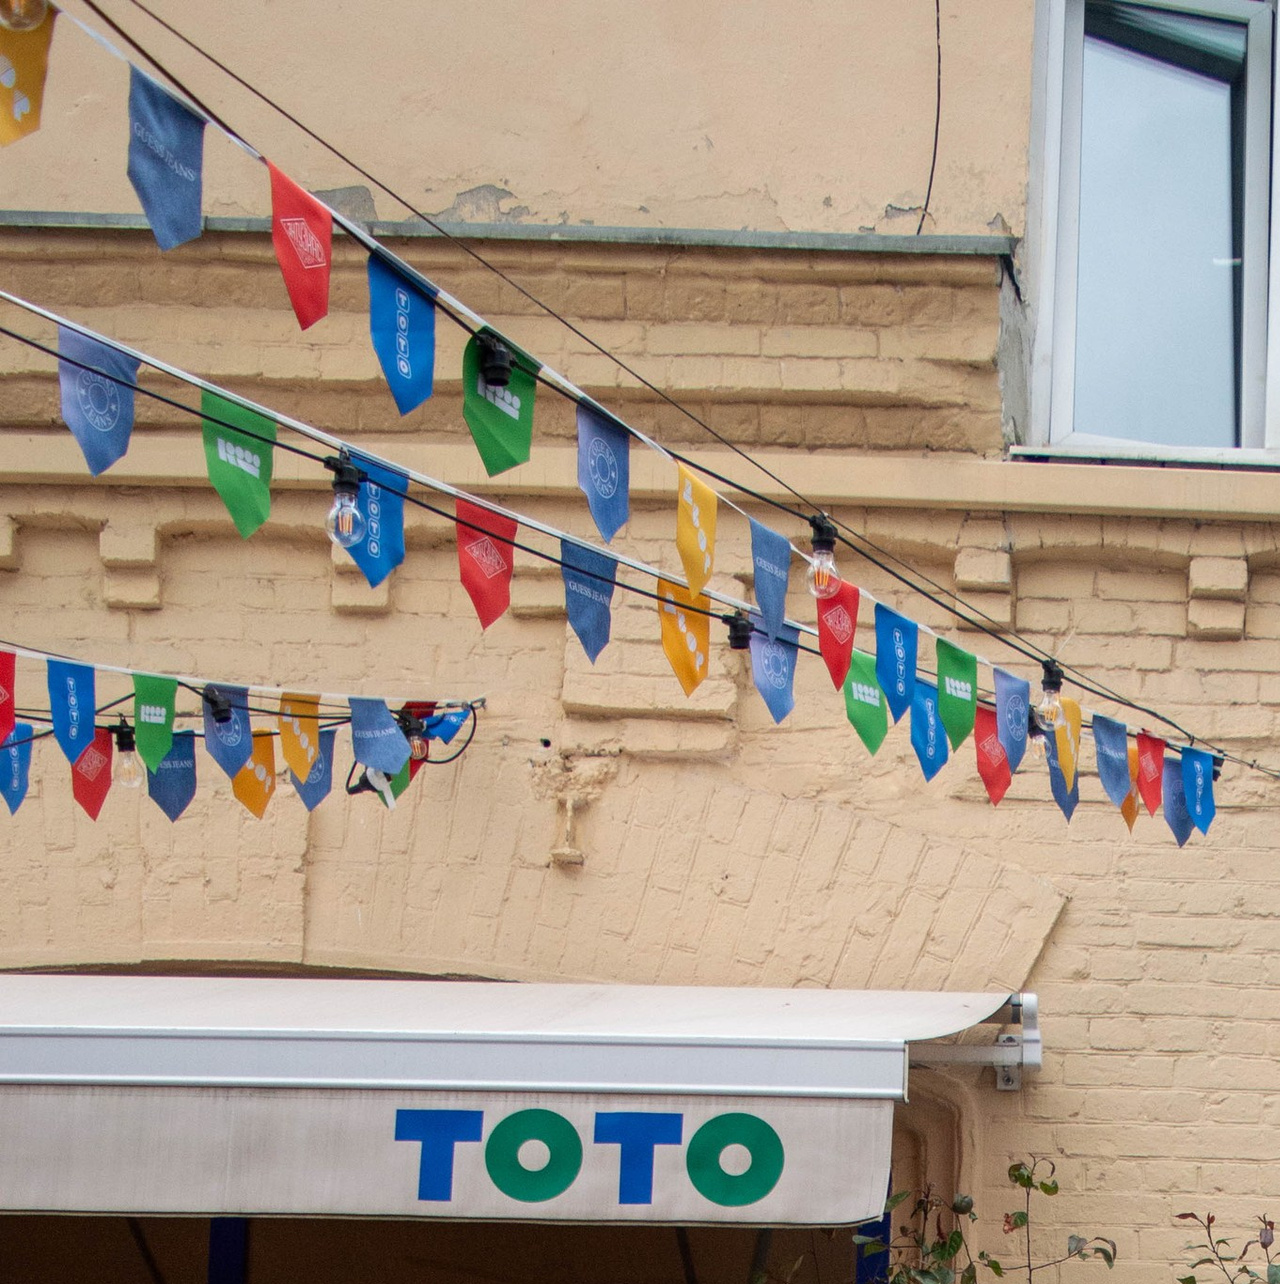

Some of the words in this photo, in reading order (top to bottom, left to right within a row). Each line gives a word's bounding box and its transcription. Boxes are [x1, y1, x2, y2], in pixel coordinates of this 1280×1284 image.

[133, 121, 166, 159] GUESS
[164, 149, 196, 182] JEANS
[396, 288, 411, 379] TOTO
[83, 403, 112, 428] JEANS
[589, 441, 616, 467] GUESS
[592, 470, 614, 496] JEANS
[568, 581, 592, 598] GUESS
[893, 628, 906, 696] TOTO
[67, 677, 80, 740] TOTO
[926, 698, 936, 759] TOTO
[171, 759, 194, 769] JEANS
[394, 1107, 785, 1207] TOTO
